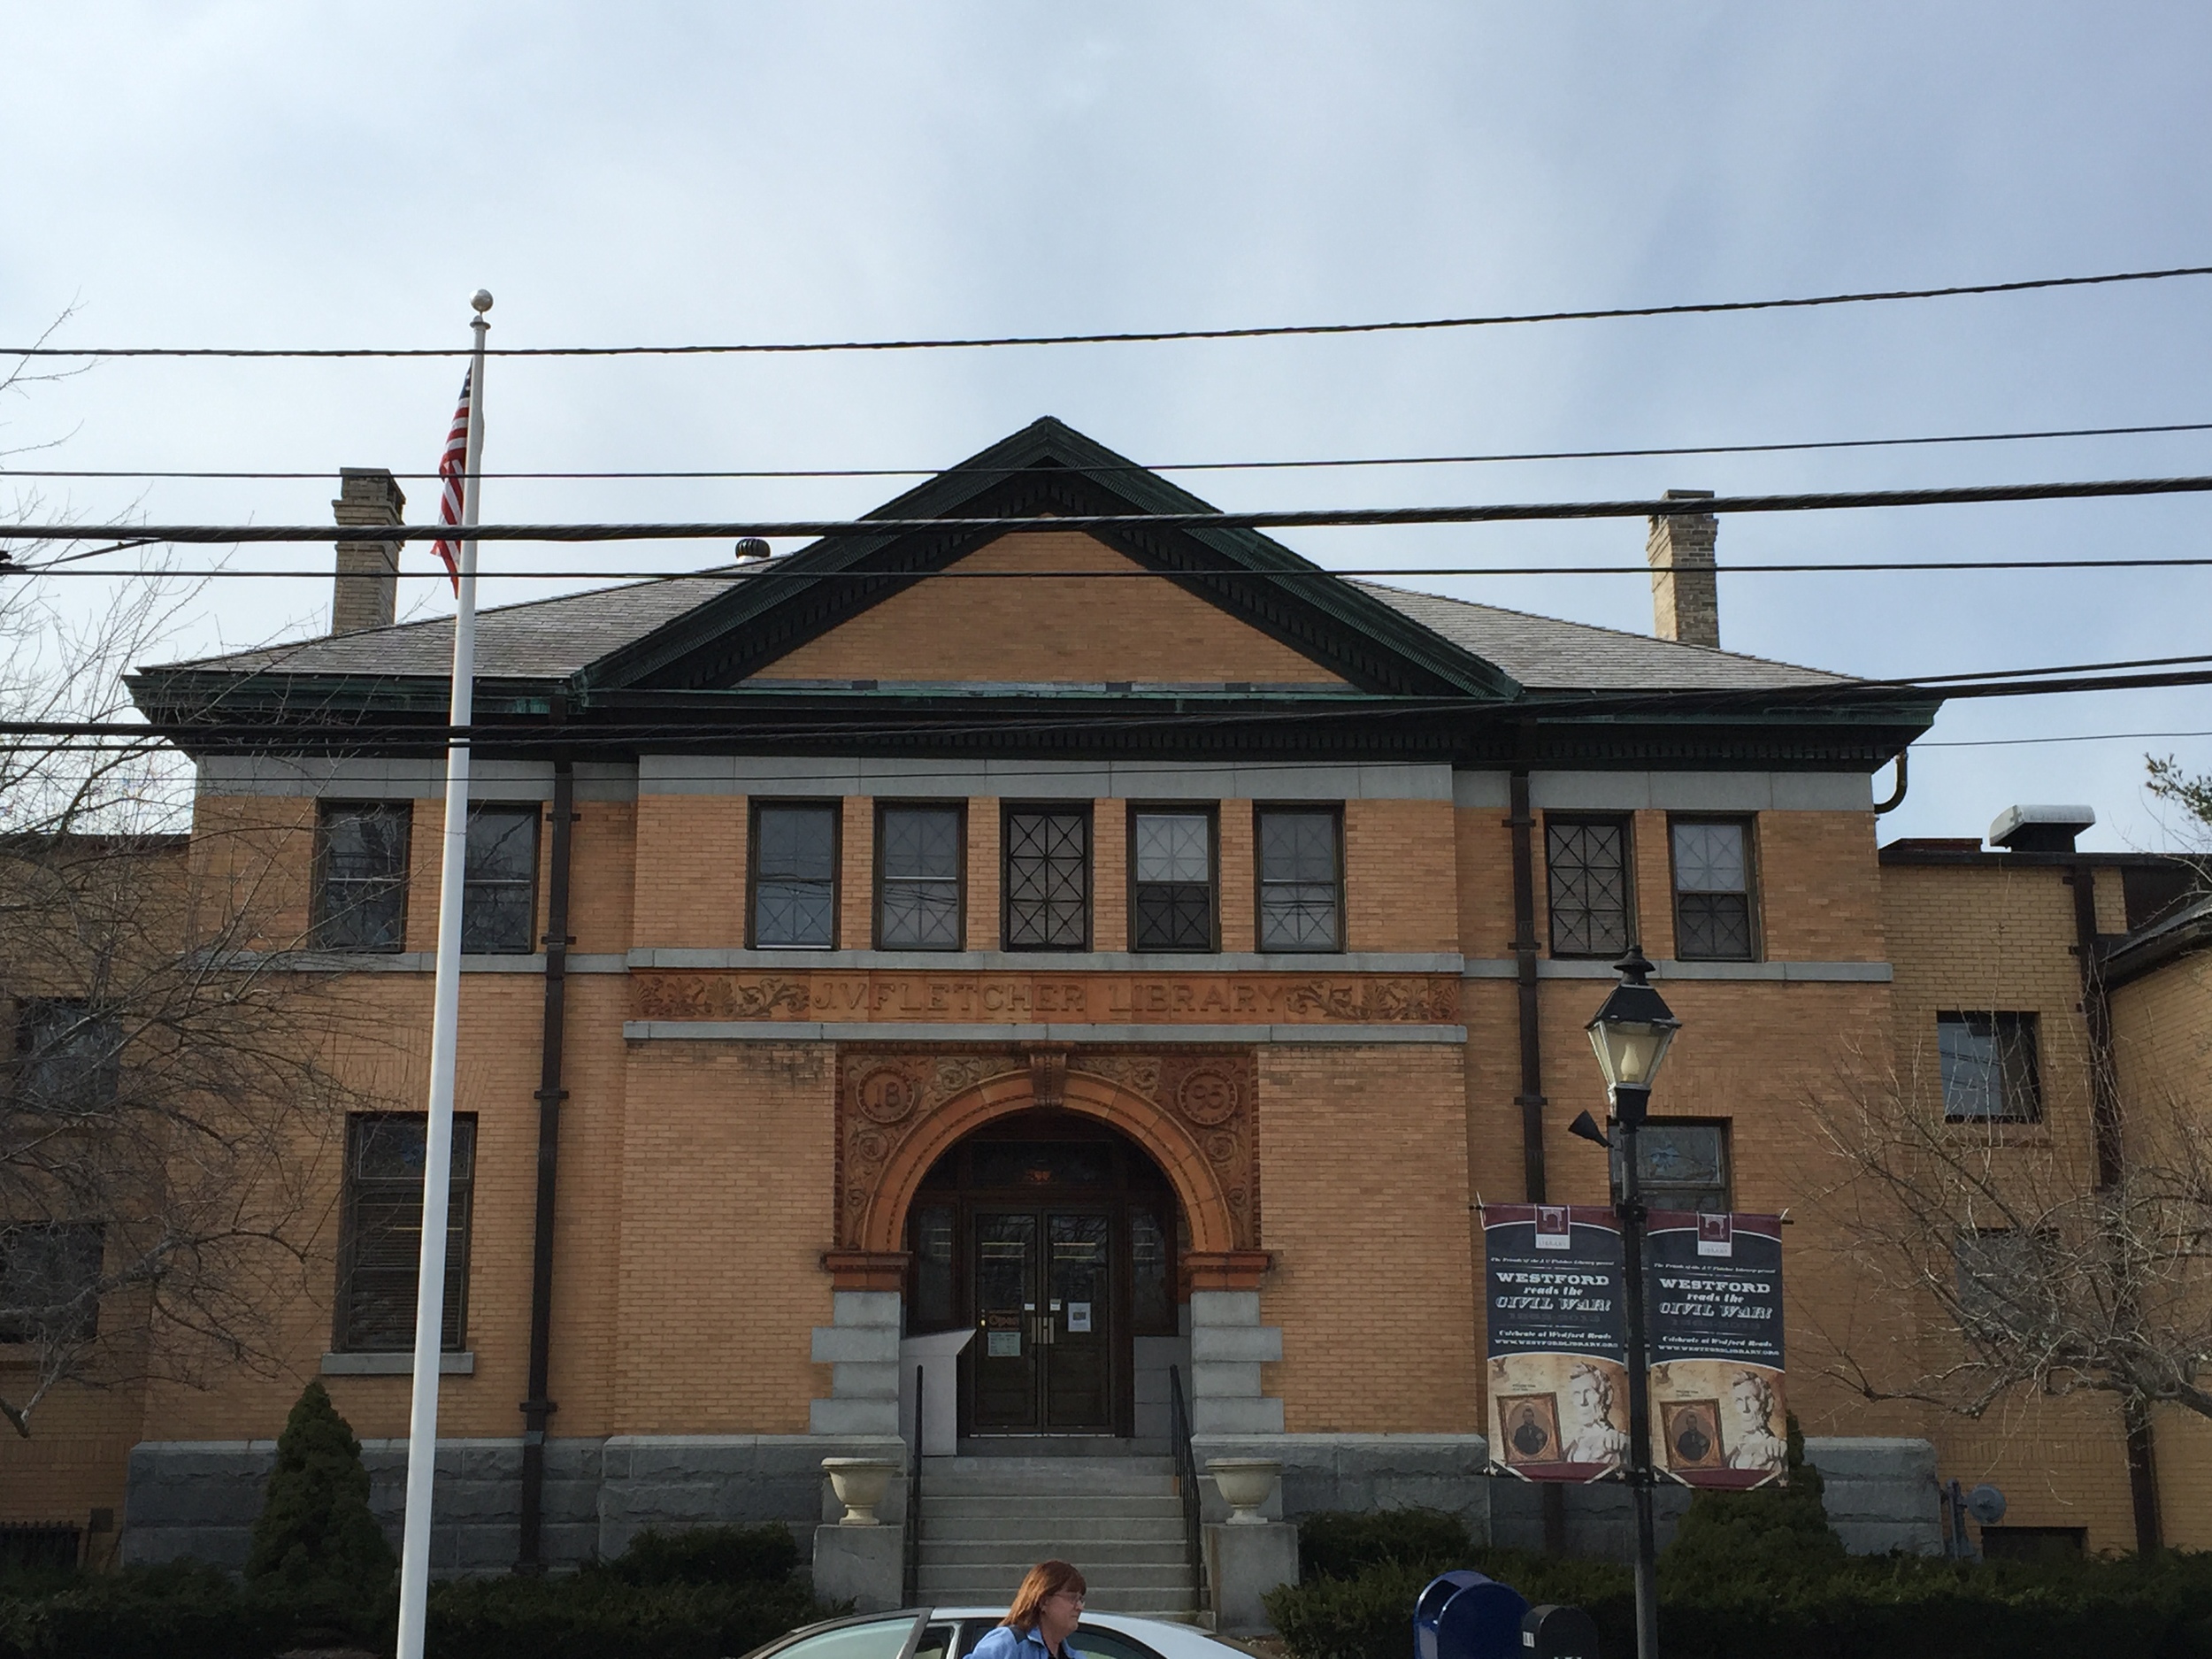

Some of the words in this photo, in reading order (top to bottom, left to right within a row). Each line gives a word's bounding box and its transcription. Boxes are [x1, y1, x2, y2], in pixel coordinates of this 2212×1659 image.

[872, 982, 1086, 1013] FLETCHER
[1108, 983, 1284, 1013] LIBRARY
[873, 1080, 901, 1108] 18
[1495, 1271, 1610, 1286] WESTFORD
[1658, 1278, 1771, 1294] WESTFORD
[1523, 1286, 1560, 1295] reads
[1563, 1286, 1584, 1296] the
[1686, 1293, 1721, 1302] reads
[1724, 1294, 1745, 1303] the
[1495, 1295, 1554, 1310] CIVIL
[1558, 1297, 1612, 1311] WAR!
[1658, 1302, 1715, 1317] CIVIL
[1719, 1304, 1773, 1319] WAR!
